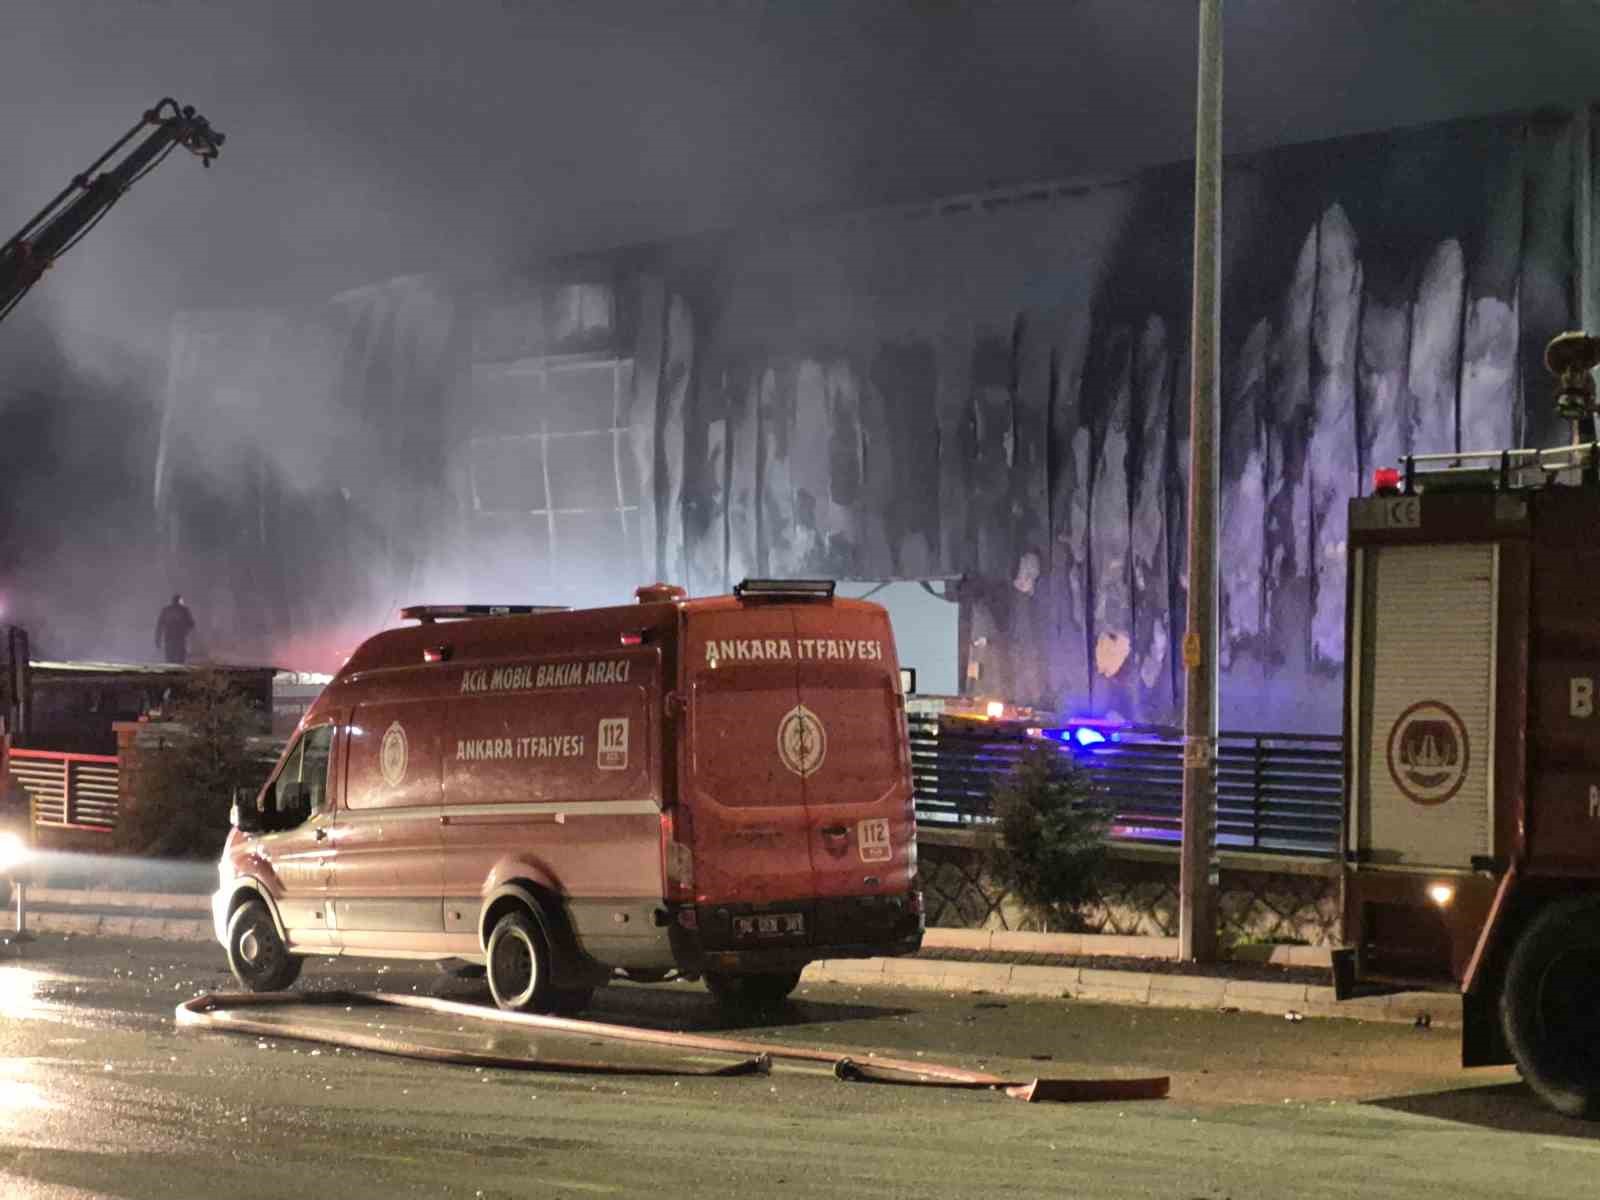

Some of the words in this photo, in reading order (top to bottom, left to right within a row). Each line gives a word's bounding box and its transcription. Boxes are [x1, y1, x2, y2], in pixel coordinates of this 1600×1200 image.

[705, 639, 792, 660] ANKARA
[536, 663, 583, 687] BAKIM
[585, 660, 630, 685] ARACI
[603, 723, 624, 747] 112
[456, 738, 513, 761] ANKARA
[863, 823, 885, 843] 112
